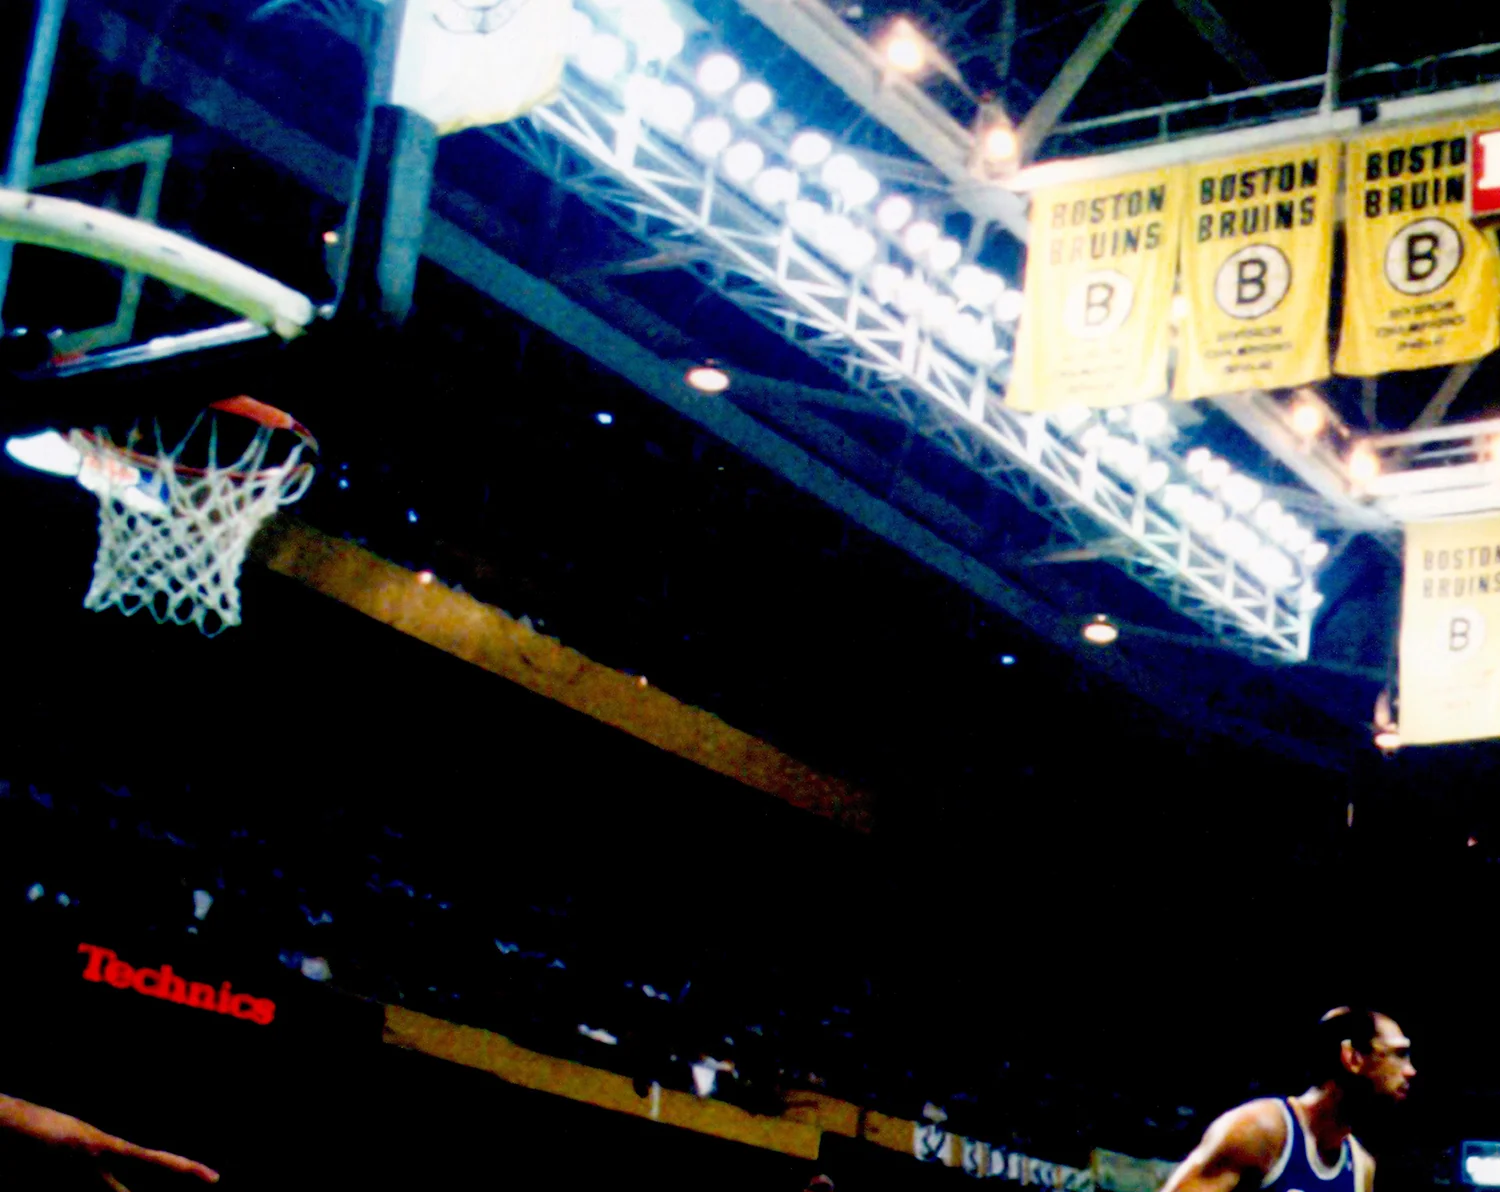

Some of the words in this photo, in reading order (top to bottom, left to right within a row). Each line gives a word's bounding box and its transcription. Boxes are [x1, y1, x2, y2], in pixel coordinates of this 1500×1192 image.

[1365, 137, 1466, 181] BOSTO
[1200, 158, 1319, 205] BOSTON
[1365, 174, 1465, 218] BRUIN
[1052, 185, 1166, 229] BOSTON
[1197, 195, 1316, 243] BRUINS
[1050, 221, 1161, 265] BRUINS
[1407, 232, 1439, 281] B
[1236, 258, 1268, 304] B
[1085, 282, 1114, 326] B
[1449, 617, 1471, 651] B
[78, 942, 276, 1025] Technics
